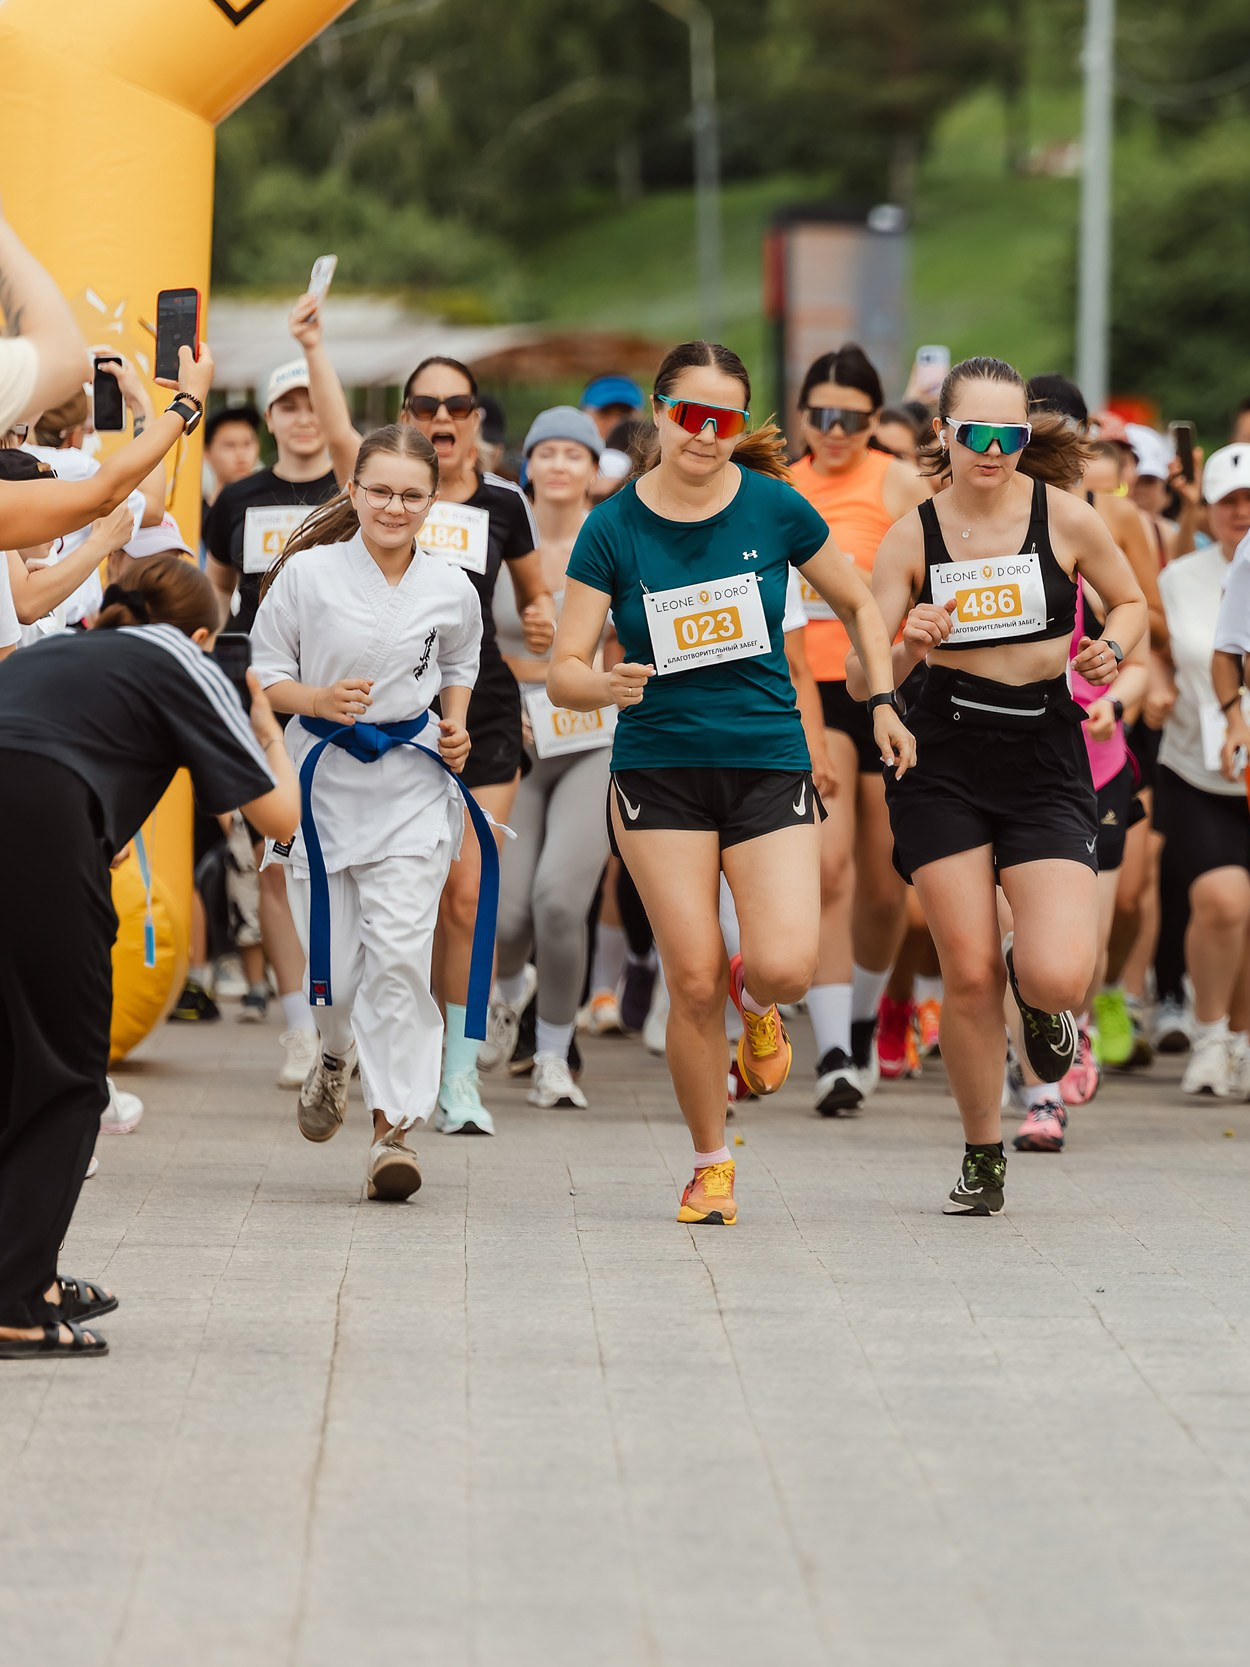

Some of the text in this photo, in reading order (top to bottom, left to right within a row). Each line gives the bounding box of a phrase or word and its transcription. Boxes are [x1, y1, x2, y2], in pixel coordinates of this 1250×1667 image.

[418, 526, 464, 548] 484
[940, 565, 1031, 584] LEONE D'ORO
[655, 585, 748, 613] LEONE D'ORO
[962, 588, 1015, 617] 486
[681, 611, 735, 645] 023
[953, 618, 1036, 634] АГОТВОРИТЕЛЬНЫЙ ЗАБЕГ
[667, 639, 758, 664] БЛАГОТВОРИТЕЛЬНЫЙ ЗАБЕГ
